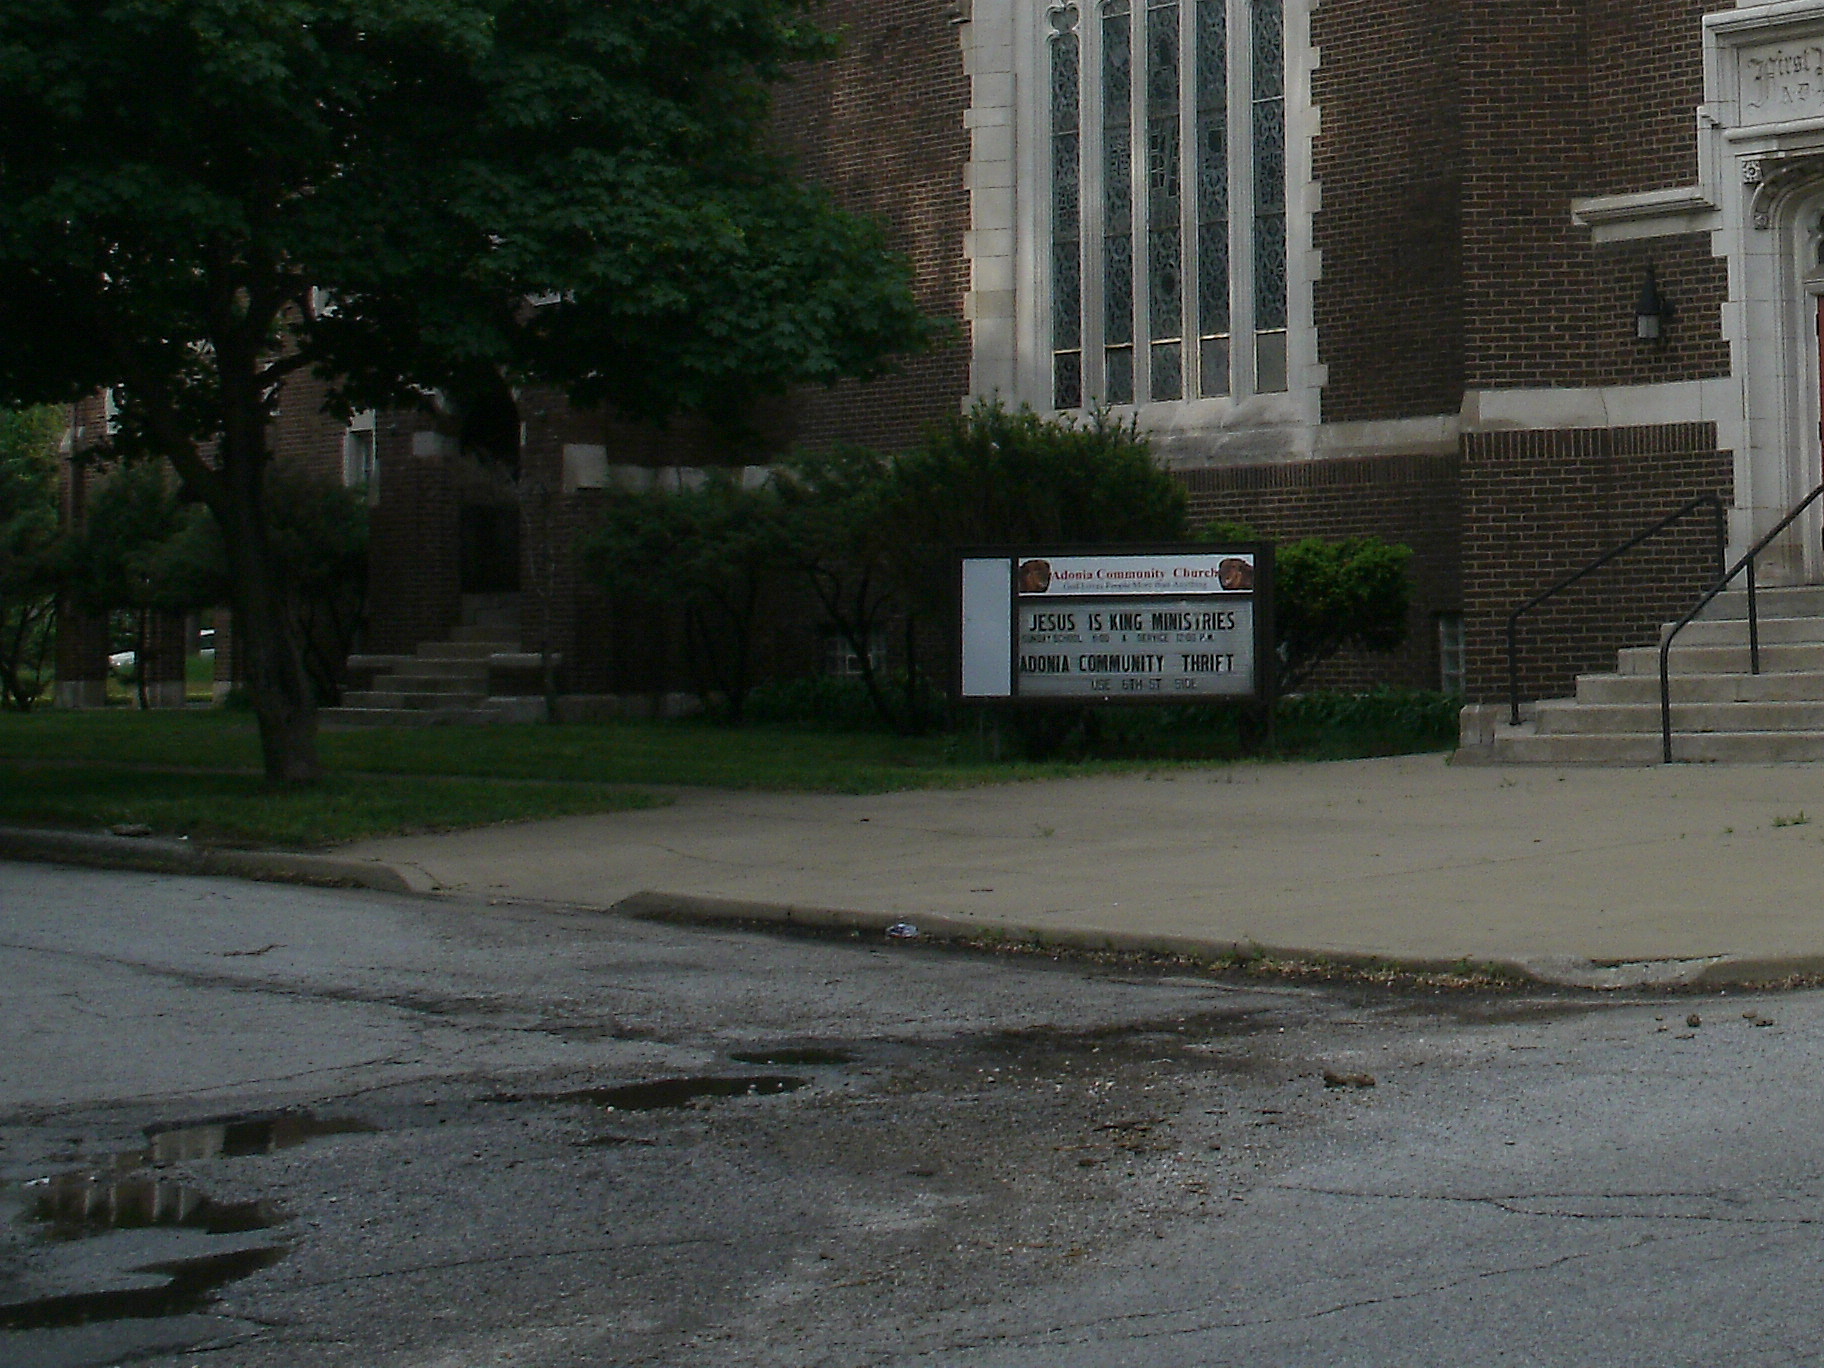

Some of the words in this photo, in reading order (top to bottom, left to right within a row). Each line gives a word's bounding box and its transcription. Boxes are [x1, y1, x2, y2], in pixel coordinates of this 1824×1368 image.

[1051, 570, 1093, 580] Adonia
[1096, 568, 1166, 580] Community
[1173, 567, 1218, 578] Church
[1029, 613, 1075, 631] JESUS
[1089, 613, 1102, 630] IS
[1110, 613, 1142, 630] KING
[1152, 612, 1235, 630] MINISTRIES
[1019, 654, 1070, 672] ADONIA
[1079, 654, 1164, 672] COMMUNITY
[1182, 654, 1234, 672] THRIFT
